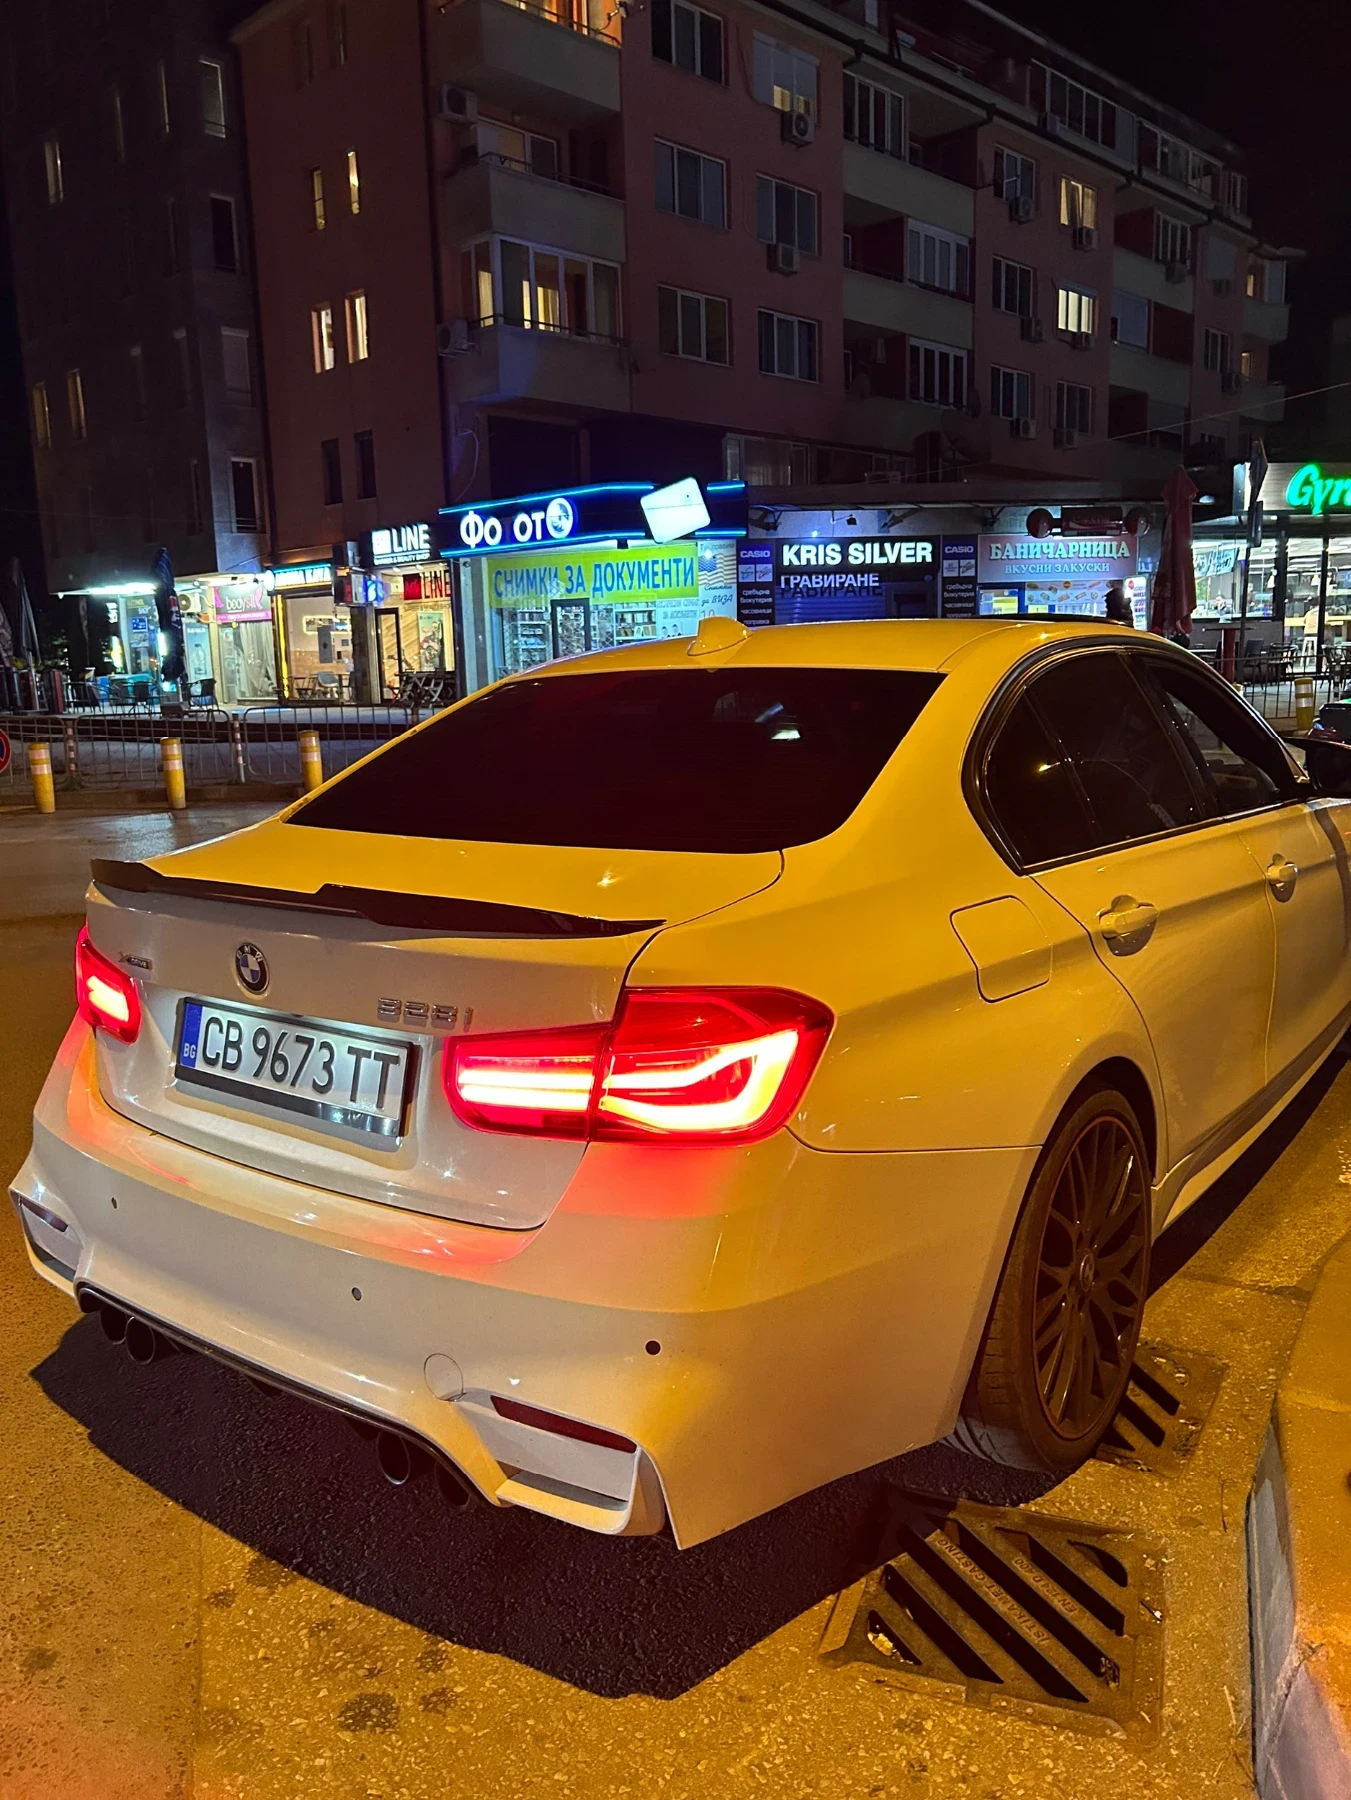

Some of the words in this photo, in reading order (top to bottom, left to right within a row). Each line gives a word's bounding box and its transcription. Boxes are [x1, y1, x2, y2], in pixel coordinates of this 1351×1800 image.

[391, 523, 430, 553] LINE
[740, 550, 771, 559] CASIO
[782, 544, 841, 566] KRIS
[847, 541, 933, 565] SILVER
[944, 545, 974, 554] CASIO
[989, 541, 1130, 560] БАНИЧАРНИЦА
[1005, 564, 1055, 574] ВКУСНИ
[1054, 563, 1110, 573] ЗАКУСКИ
[494, 567, 558, 598] СНИМКИ
[565, 564, 586, 594] ЗА
[592, 557, 695, 598] ДОКУМЕНТИ
[780, 573, 880, 589] ГРАВИРАНЕ
[183, 1043, 196, 1059] BG
[202, 1016, 243, 1071] CB
[252, 1026, 336, 1094] 9673
[347, 1046, 400, 1110] TT
